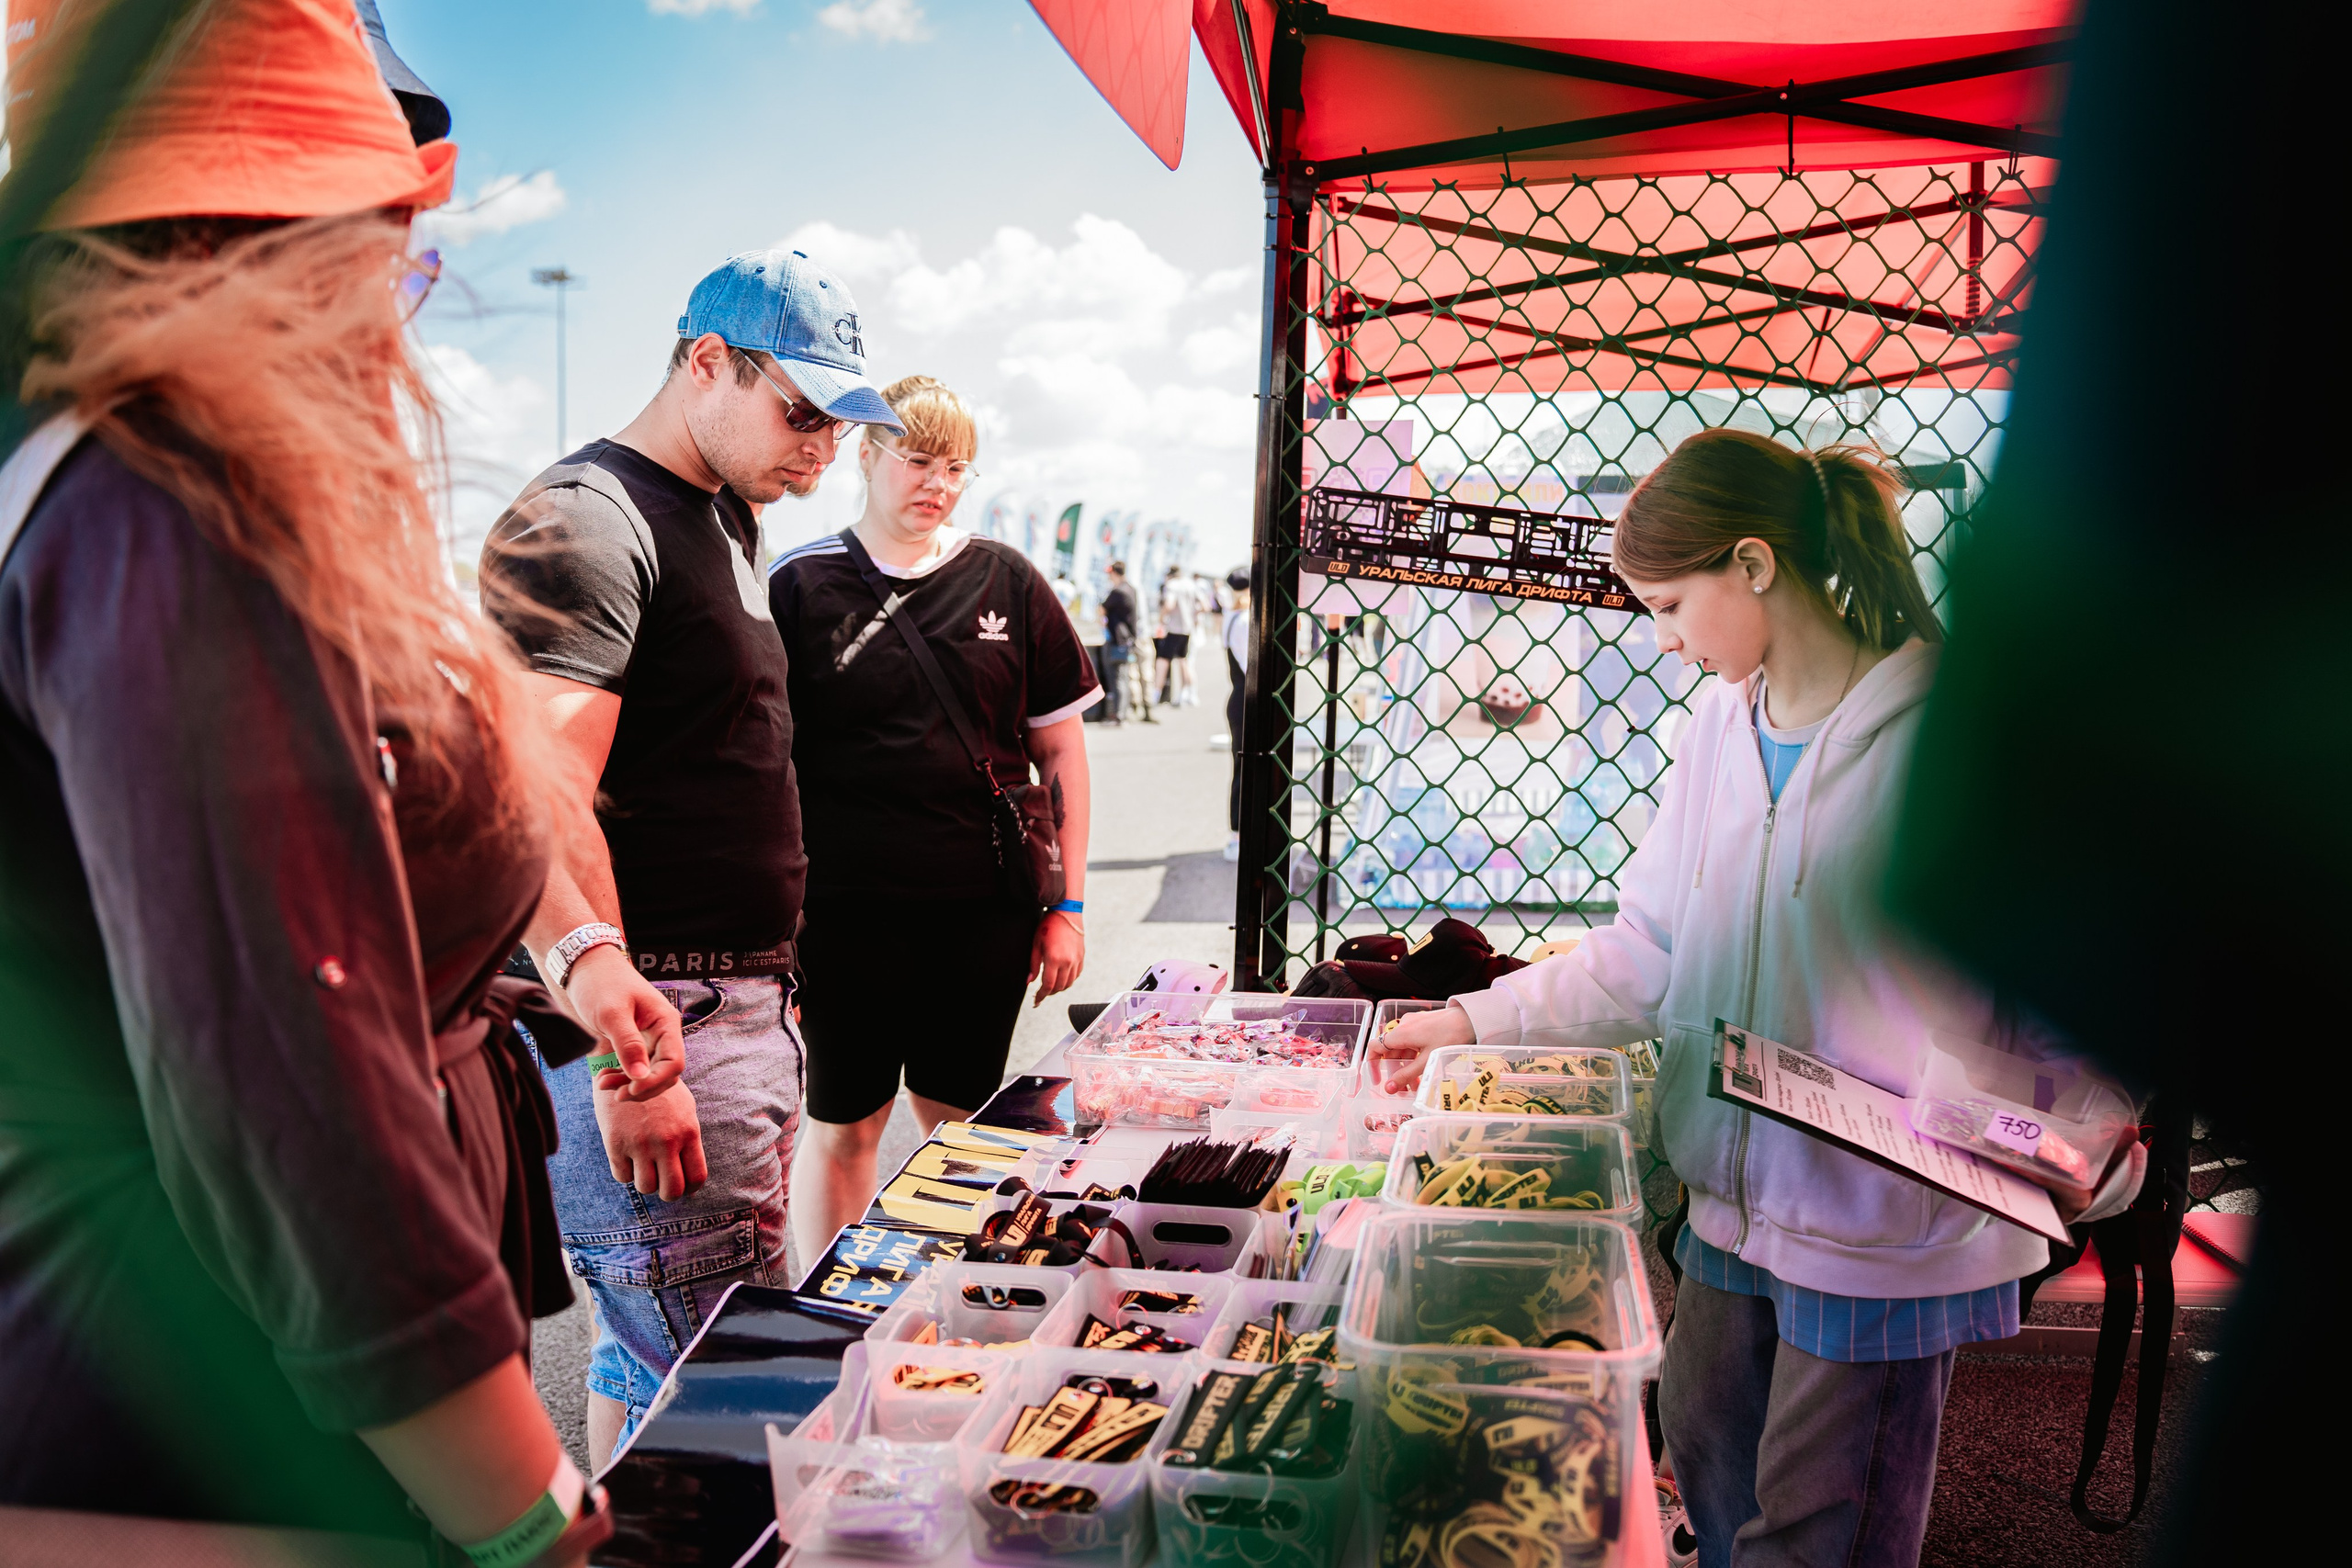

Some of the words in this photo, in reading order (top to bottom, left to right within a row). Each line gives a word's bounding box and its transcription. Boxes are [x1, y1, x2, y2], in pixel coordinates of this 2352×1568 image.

[1329, 562, 1349, 573] ULD
[1359, 564, 1464, 588] УРАЛЬСКАЯ
[1465, 577, 1514, 594] ЛИГА
[1516, 583, 1593, 604] ДРИФТА
[1603, 595, 1624, 606] ULD
[978, 631, 1009, 641] adidas
[639, 952, 734, 972] PARIS
[1478, 1071, 1494, 1088] ULD
[1998, 1115, 2041, 1140] 750
[1310, 1174, 1330, 1195] ULD
[859, 1231, 927, 1296] ЛИГА
